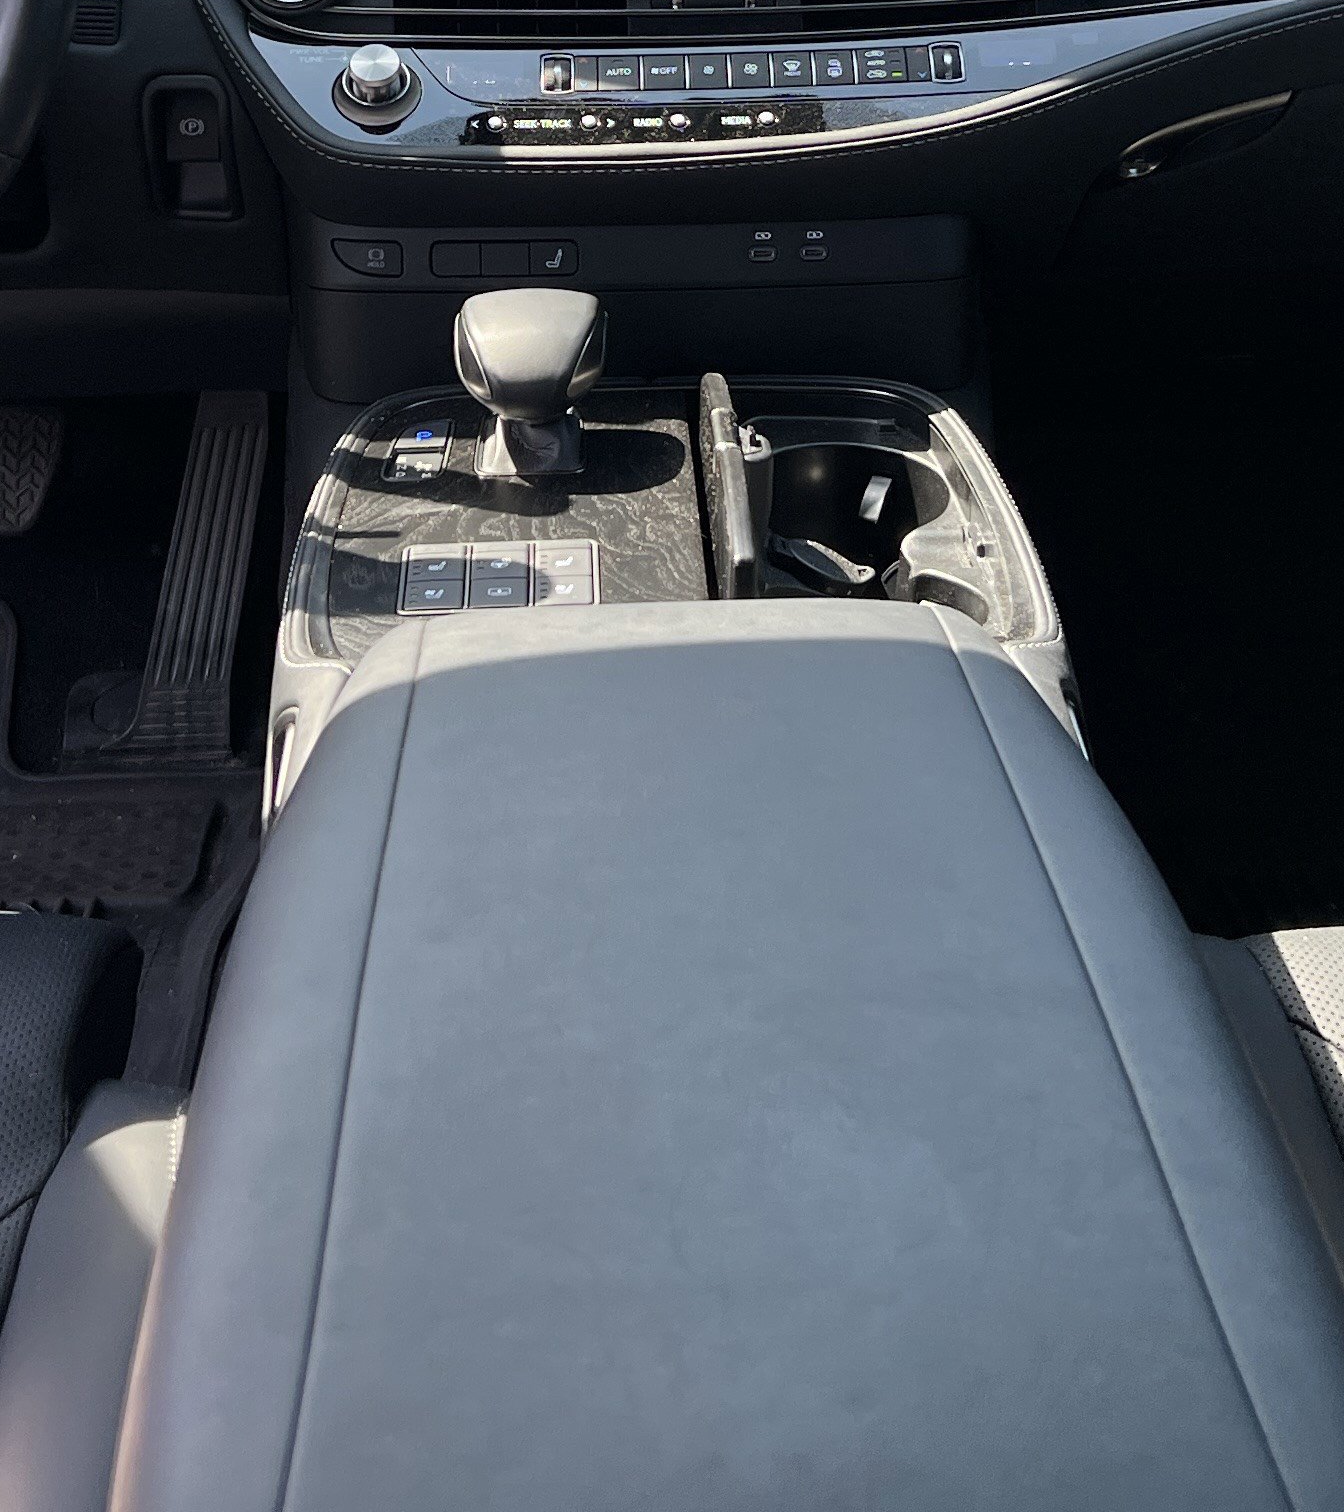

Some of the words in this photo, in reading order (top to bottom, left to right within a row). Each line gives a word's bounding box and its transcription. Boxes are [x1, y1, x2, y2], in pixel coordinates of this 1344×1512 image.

[606, 67, 631, 76] AUTO
[633, 117, 663, 127] RADIO
[721, 116, 751, 126] MEDIA
